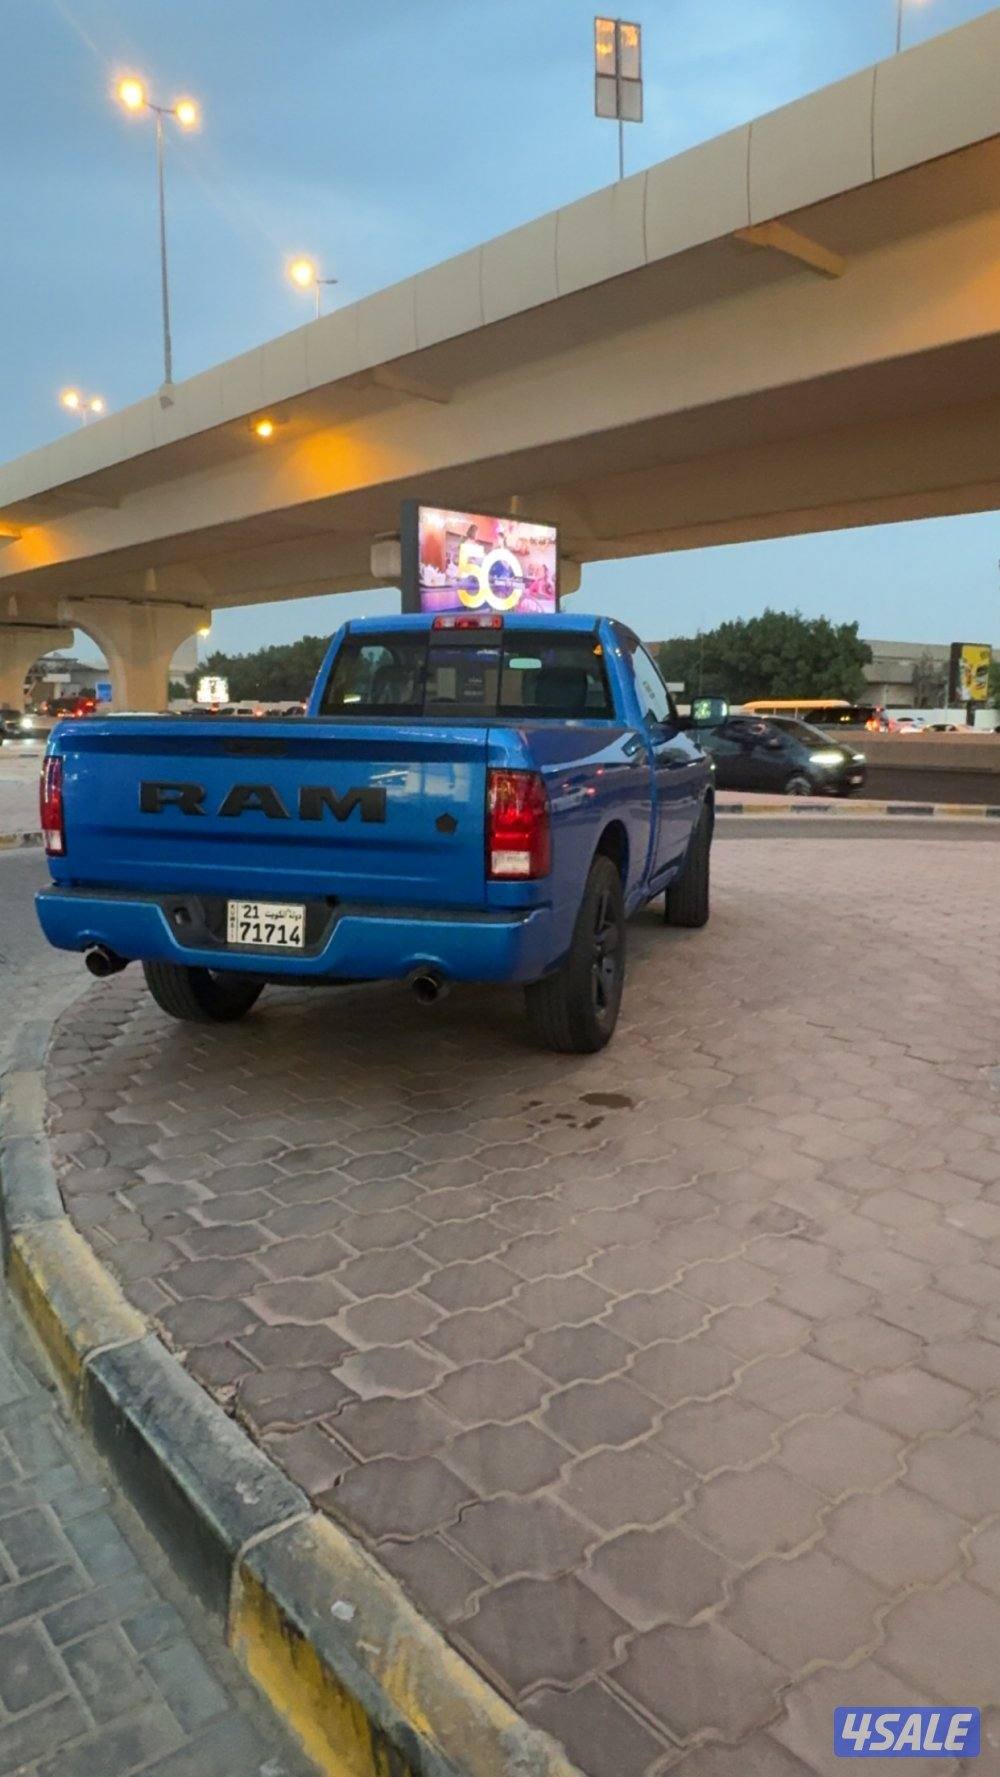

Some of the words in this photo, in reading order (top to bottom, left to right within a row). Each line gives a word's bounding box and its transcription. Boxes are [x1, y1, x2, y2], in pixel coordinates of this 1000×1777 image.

[139, 780, 387, 823] RAM
[243, 904, 259, 919] 21
[240, 921, 301, 945] 71714
